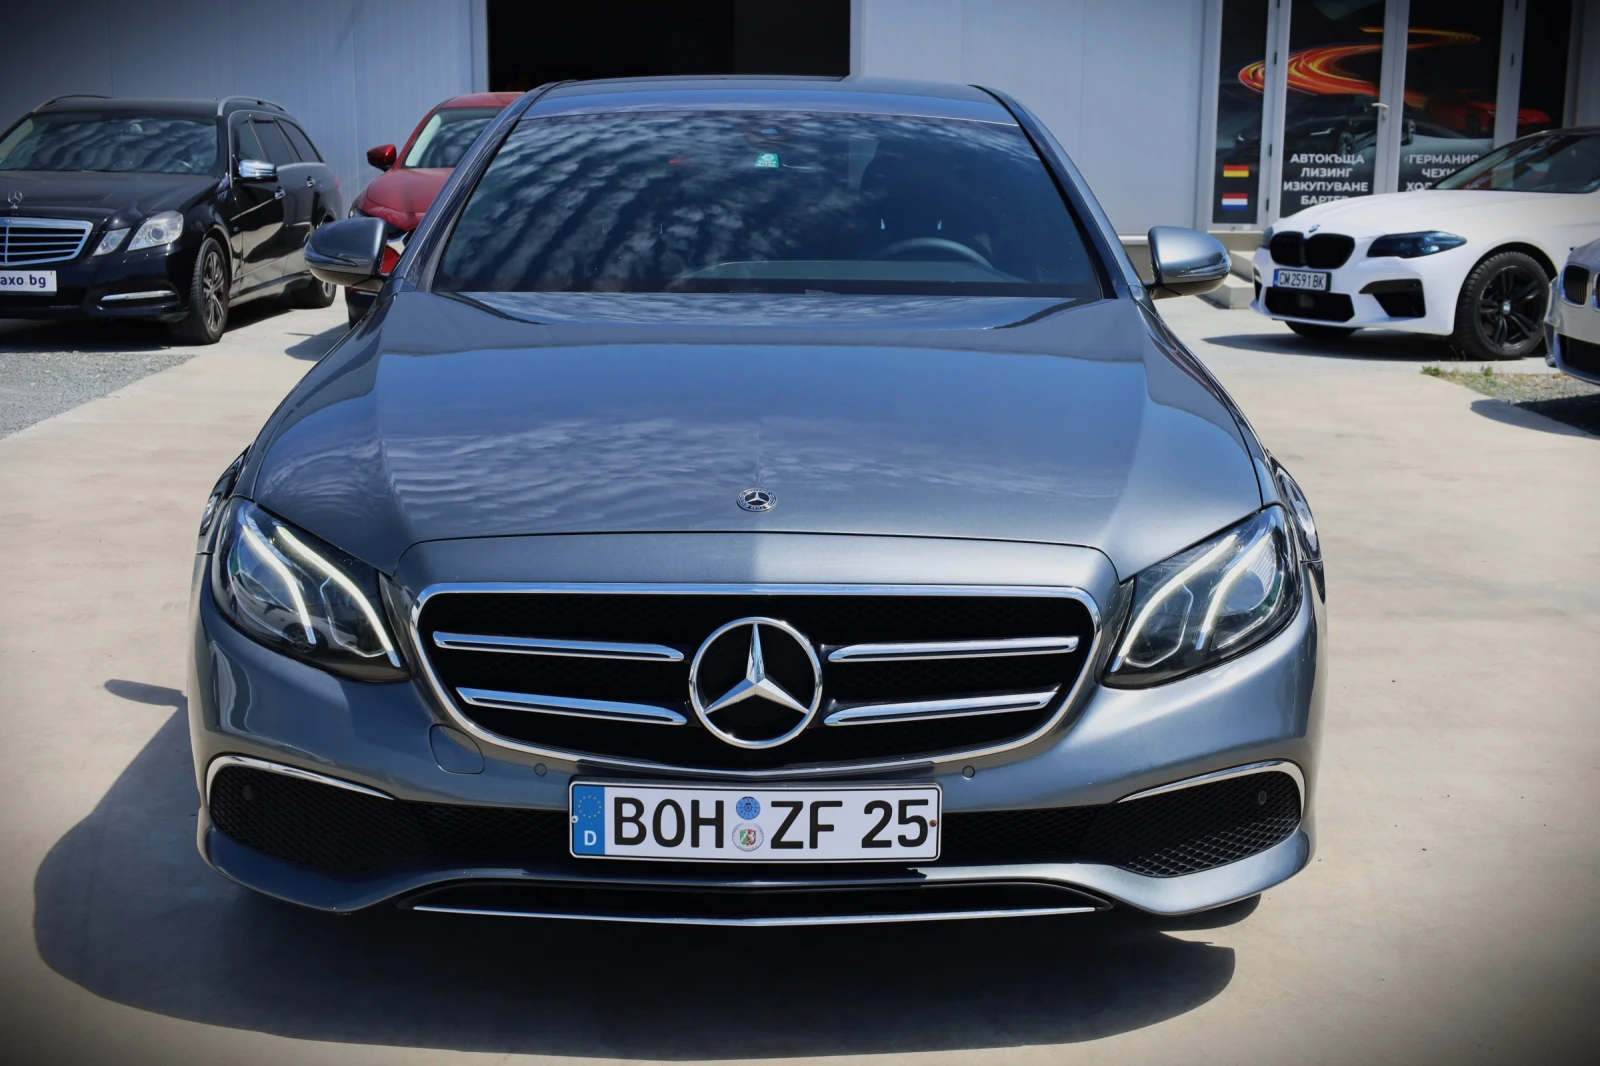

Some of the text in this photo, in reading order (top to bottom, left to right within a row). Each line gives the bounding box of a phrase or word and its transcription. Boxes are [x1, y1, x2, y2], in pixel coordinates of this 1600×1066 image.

[1290, 153, 1365, 165] АВТОКЪЩА
[1301, 167, 1353, 178] ЛИЗИНГ
[1283, 181, 1369, 192] ИЗКУПУВАНЕ
[1291, 273, 1311, 287] 2591
[1312, 274, 1325, 288] BK
[770, 800, 843, 849] ZF
[861, 799, 929, 848] 25
[584, 830, 597, 846] D
